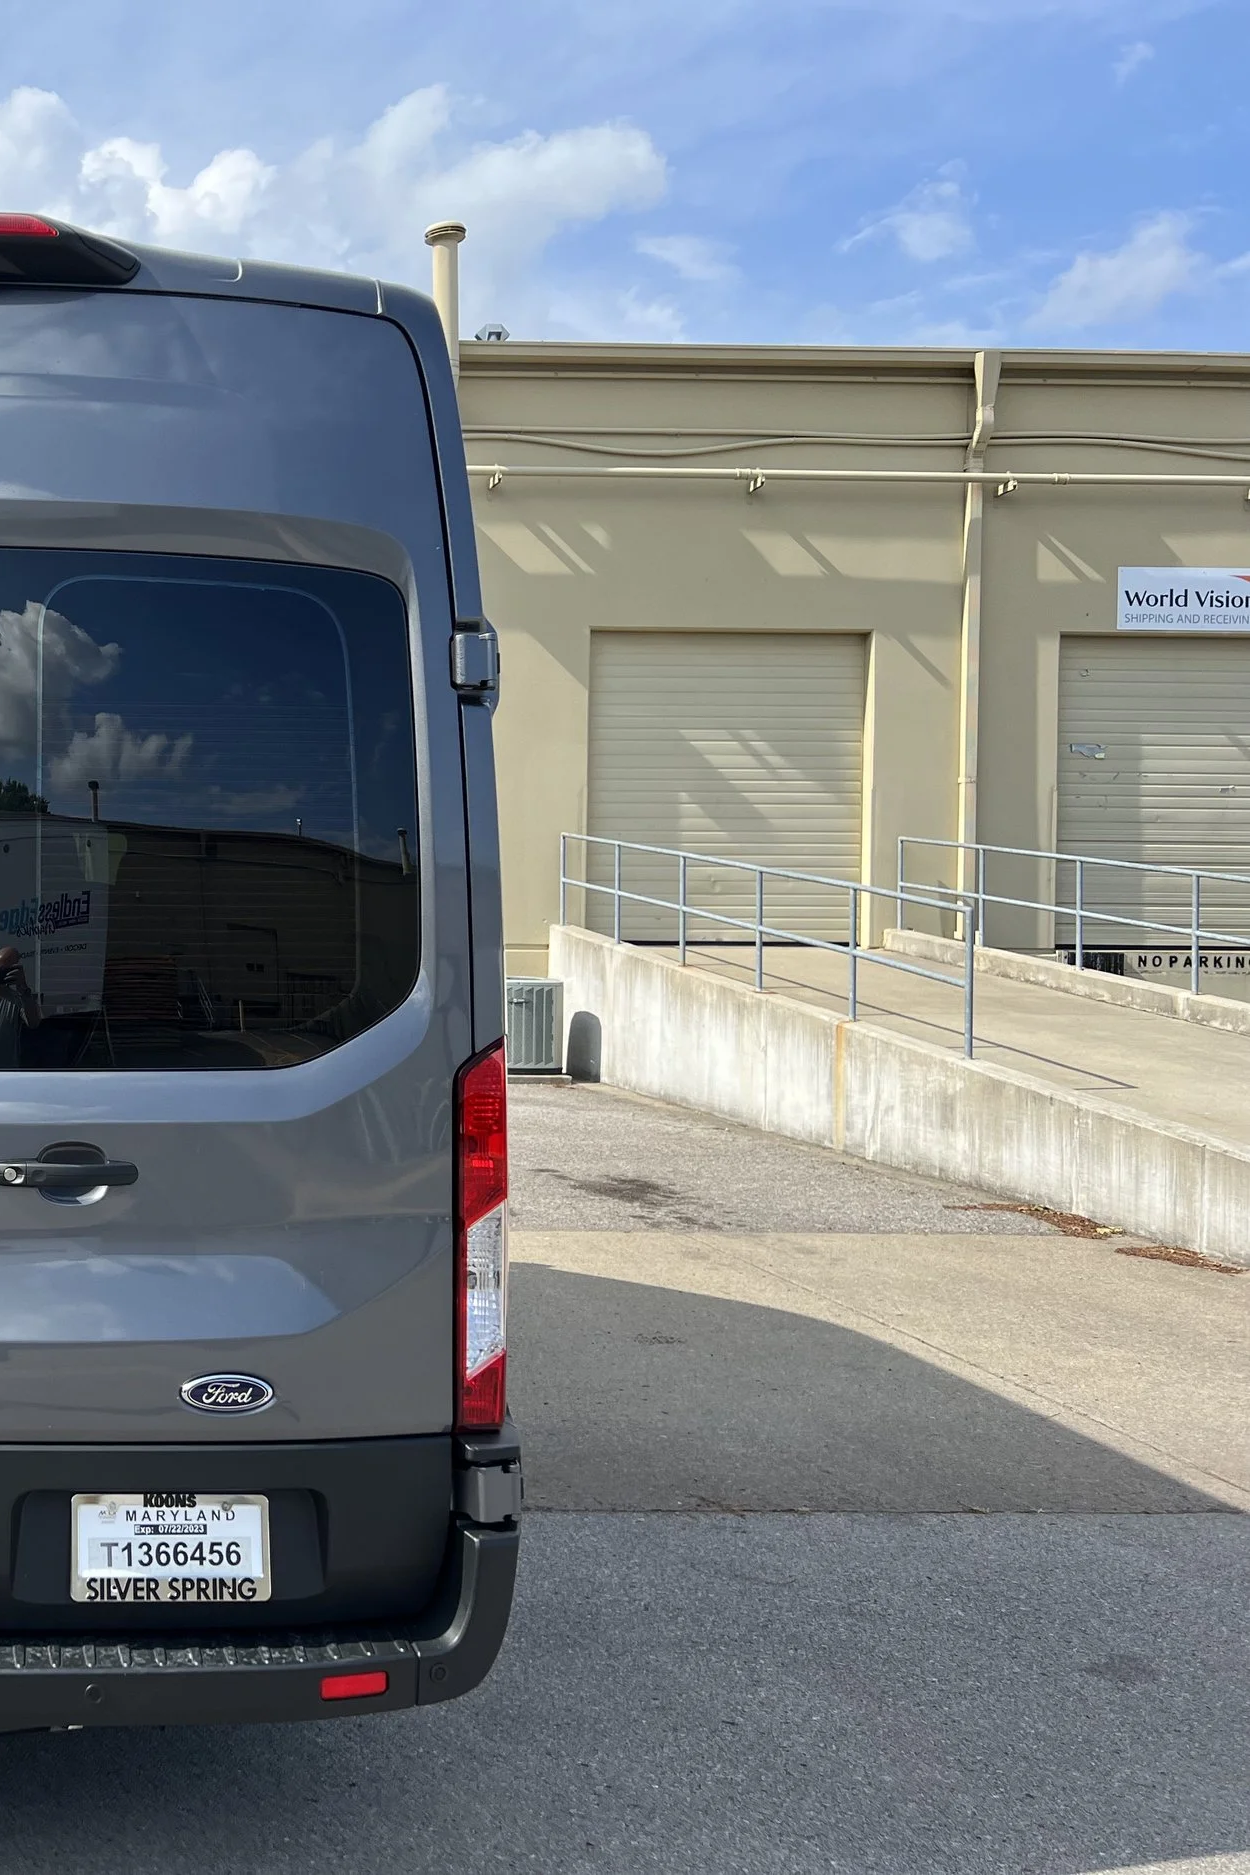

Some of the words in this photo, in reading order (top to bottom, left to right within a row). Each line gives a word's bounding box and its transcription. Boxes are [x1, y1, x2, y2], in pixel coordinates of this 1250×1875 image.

[1124, 588, 1188, 608] World
[1124, 613, 1174, 624] SHIPPING
[1176, 614, 1201, 624] AND
[1203, 614, 1250, 625] RECEIVIN
[202, 1382, 253, 1404] Ford
[143, 1494, 197, 1508] KOONS
[126, 1510, 236, 1522] MARYLAND
[158, 1524, 205, 1534] 07/22/2023
[100, 1541, 241, 1567] T1366456
[86, 1577, 160, 1601] SILVER
[168, 1577, 257, 1601] SPRING
